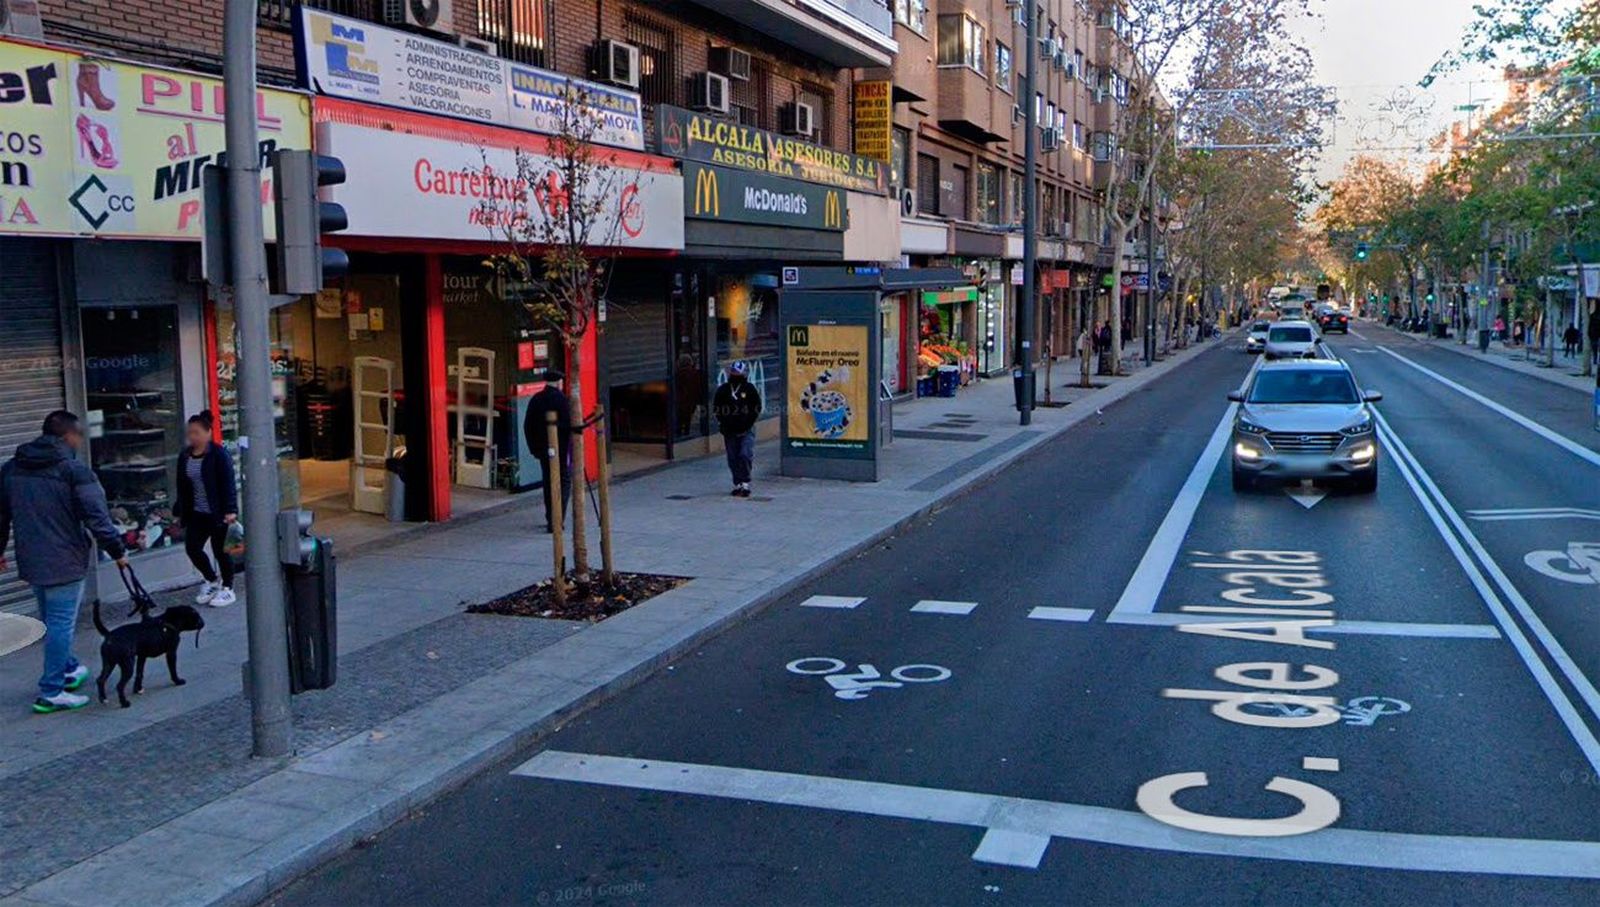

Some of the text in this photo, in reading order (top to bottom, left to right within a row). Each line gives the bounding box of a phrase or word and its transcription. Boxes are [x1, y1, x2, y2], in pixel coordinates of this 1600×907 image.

[405, 39, 501, 71] ADMINISTRACIONES
[406, 53, 503, 84] ARRENDAMIENTOS
[407, 67, 491, 94] COMPRAVENTAS
[409, 81, 461, 101] ASESORIA
[857, 82, 888, 97] FINCAS
[411, 95, 492, 120] VALORACIONES
[513, 93, 526, 109] L.
[603, 113, 640, 134] MOYA
[167, 122, 198, 161] al
[690, 115, 764, 154] ALCALA
[713, 148, 793, 176] ASESORIA
[414, 158, 528, 202] Carrefour
[744, 186, 808, 215] McDonald's
[796, 358, 834, 369] McFlurry
